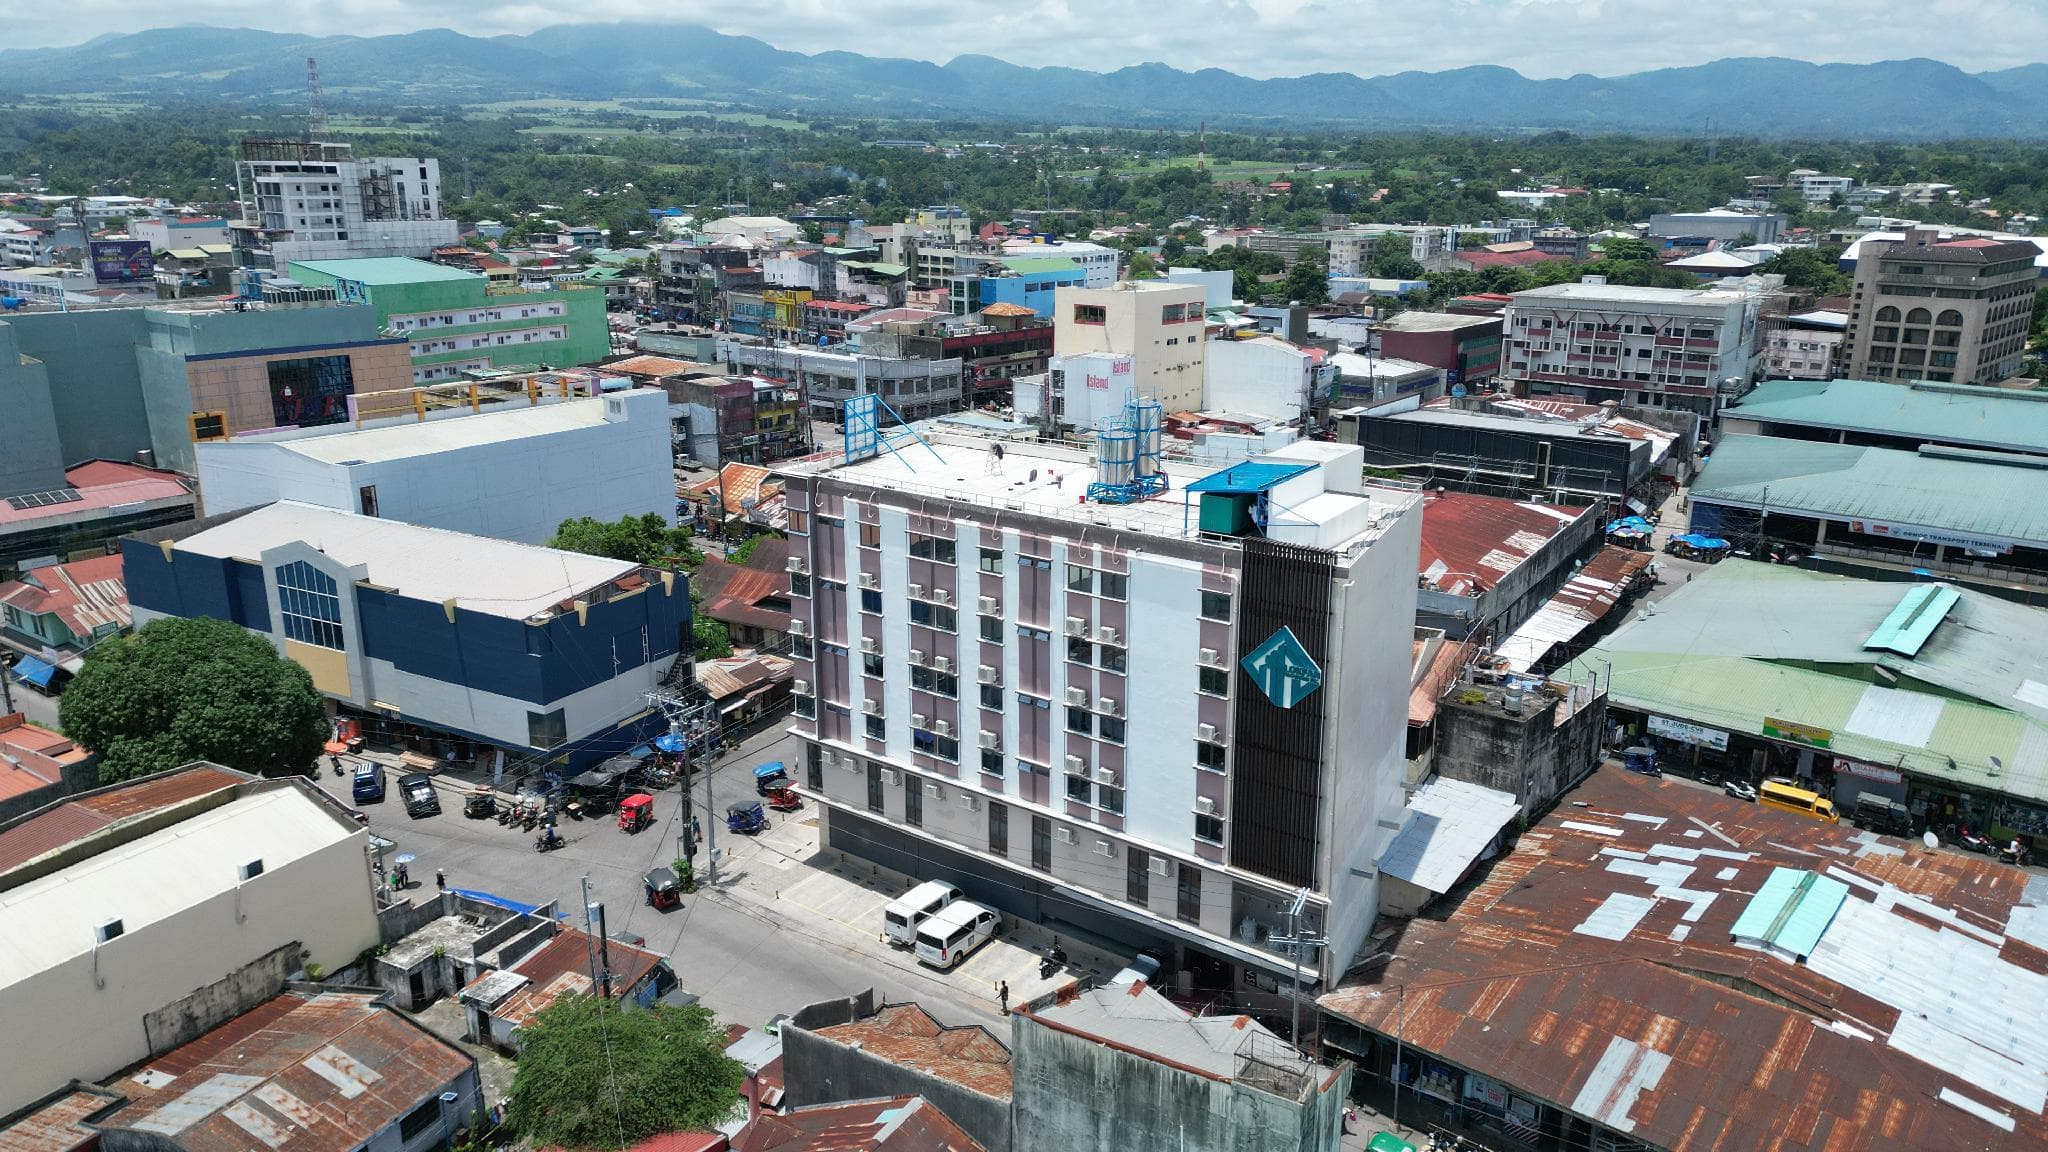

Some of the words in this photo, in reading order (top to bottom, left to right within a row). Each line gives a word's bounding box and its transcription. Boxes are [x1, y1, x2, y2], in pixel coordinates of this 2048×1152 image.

[1112, 359, 1131, 375] Island
[1087, 374, 1109, 389] Island
[1929, 534, 1969, 545] TRANSPORT
[1970, 540, 2006, 551] TERMINAL
